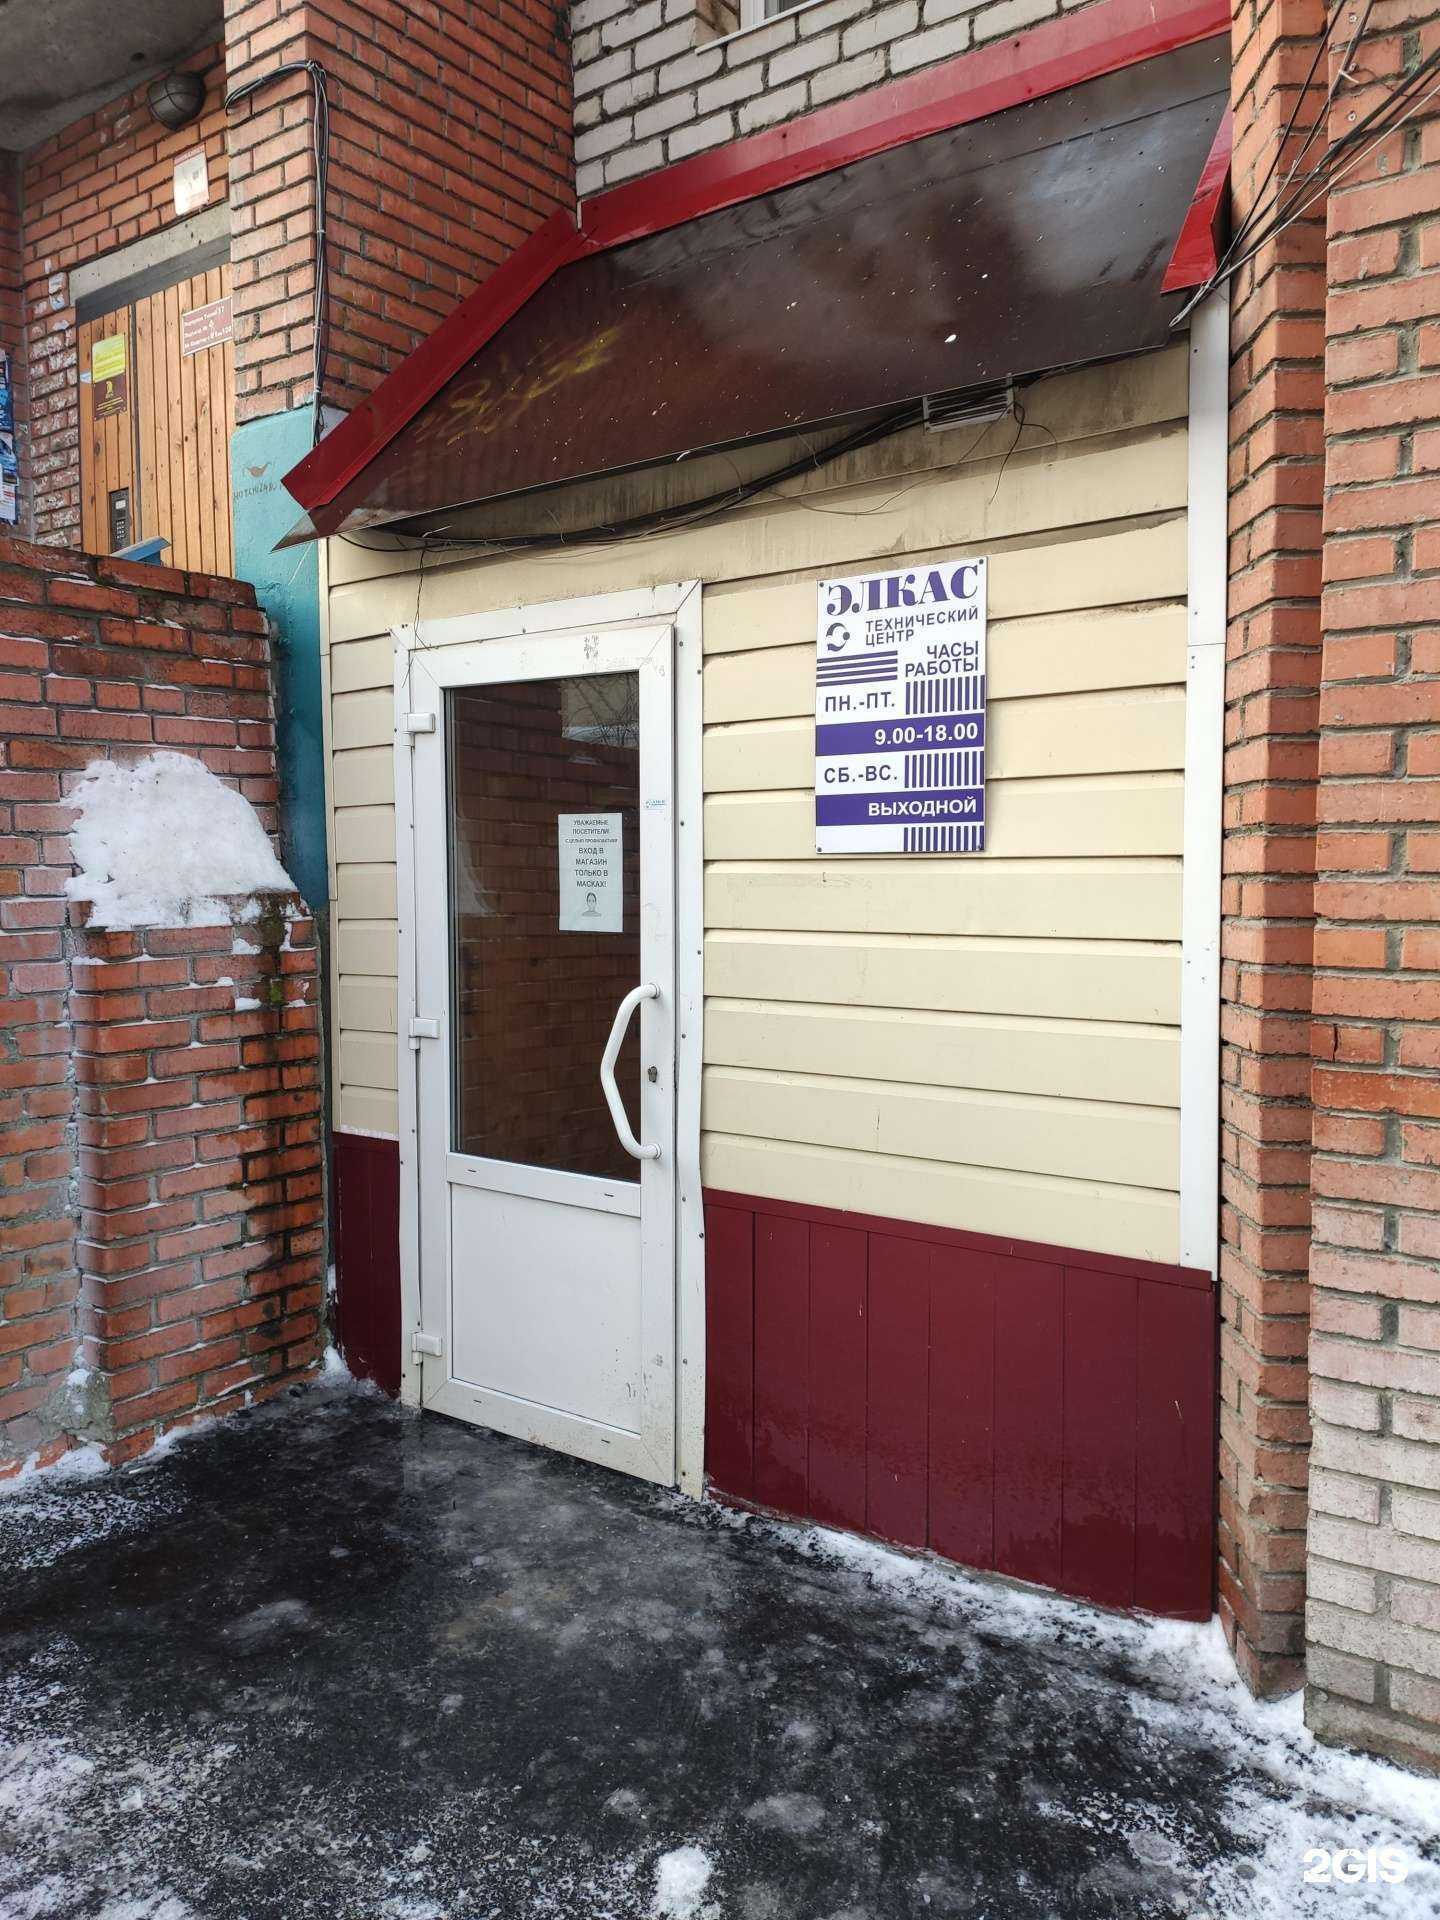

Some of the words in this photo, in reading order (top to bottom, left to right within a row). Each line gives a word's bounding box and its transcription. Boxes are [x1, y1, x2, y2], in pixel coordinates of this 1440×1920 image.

[826, 564, 978, 616] ЭЛКАС
[866, 606, 978, 633] ТЕХНИЧЕСКИЙ
[866, 629, 914, 647] ЦЕНТР
[927, 641, 979, 659] ЧАСЫ
[906, 657, 979, 677] РАБОТЫ
[825, 692, 895, 712] ПН.-ПТ.
[874, 722, 978, 746] 9.00-18.00
[824, 766, 897, 783] СБ.-ВС.
[868, 796, 977, 816] ВЫХОДНОЙ
[578, 847, 598, 855] ВХОД
[575, 858, 608, 866] МАГАЗИН
[575, 869, 602, 877] ТОЛЬКО
[603, 869, 609, 877] В
[576, 880, 607, 888] МАСКАХ!
